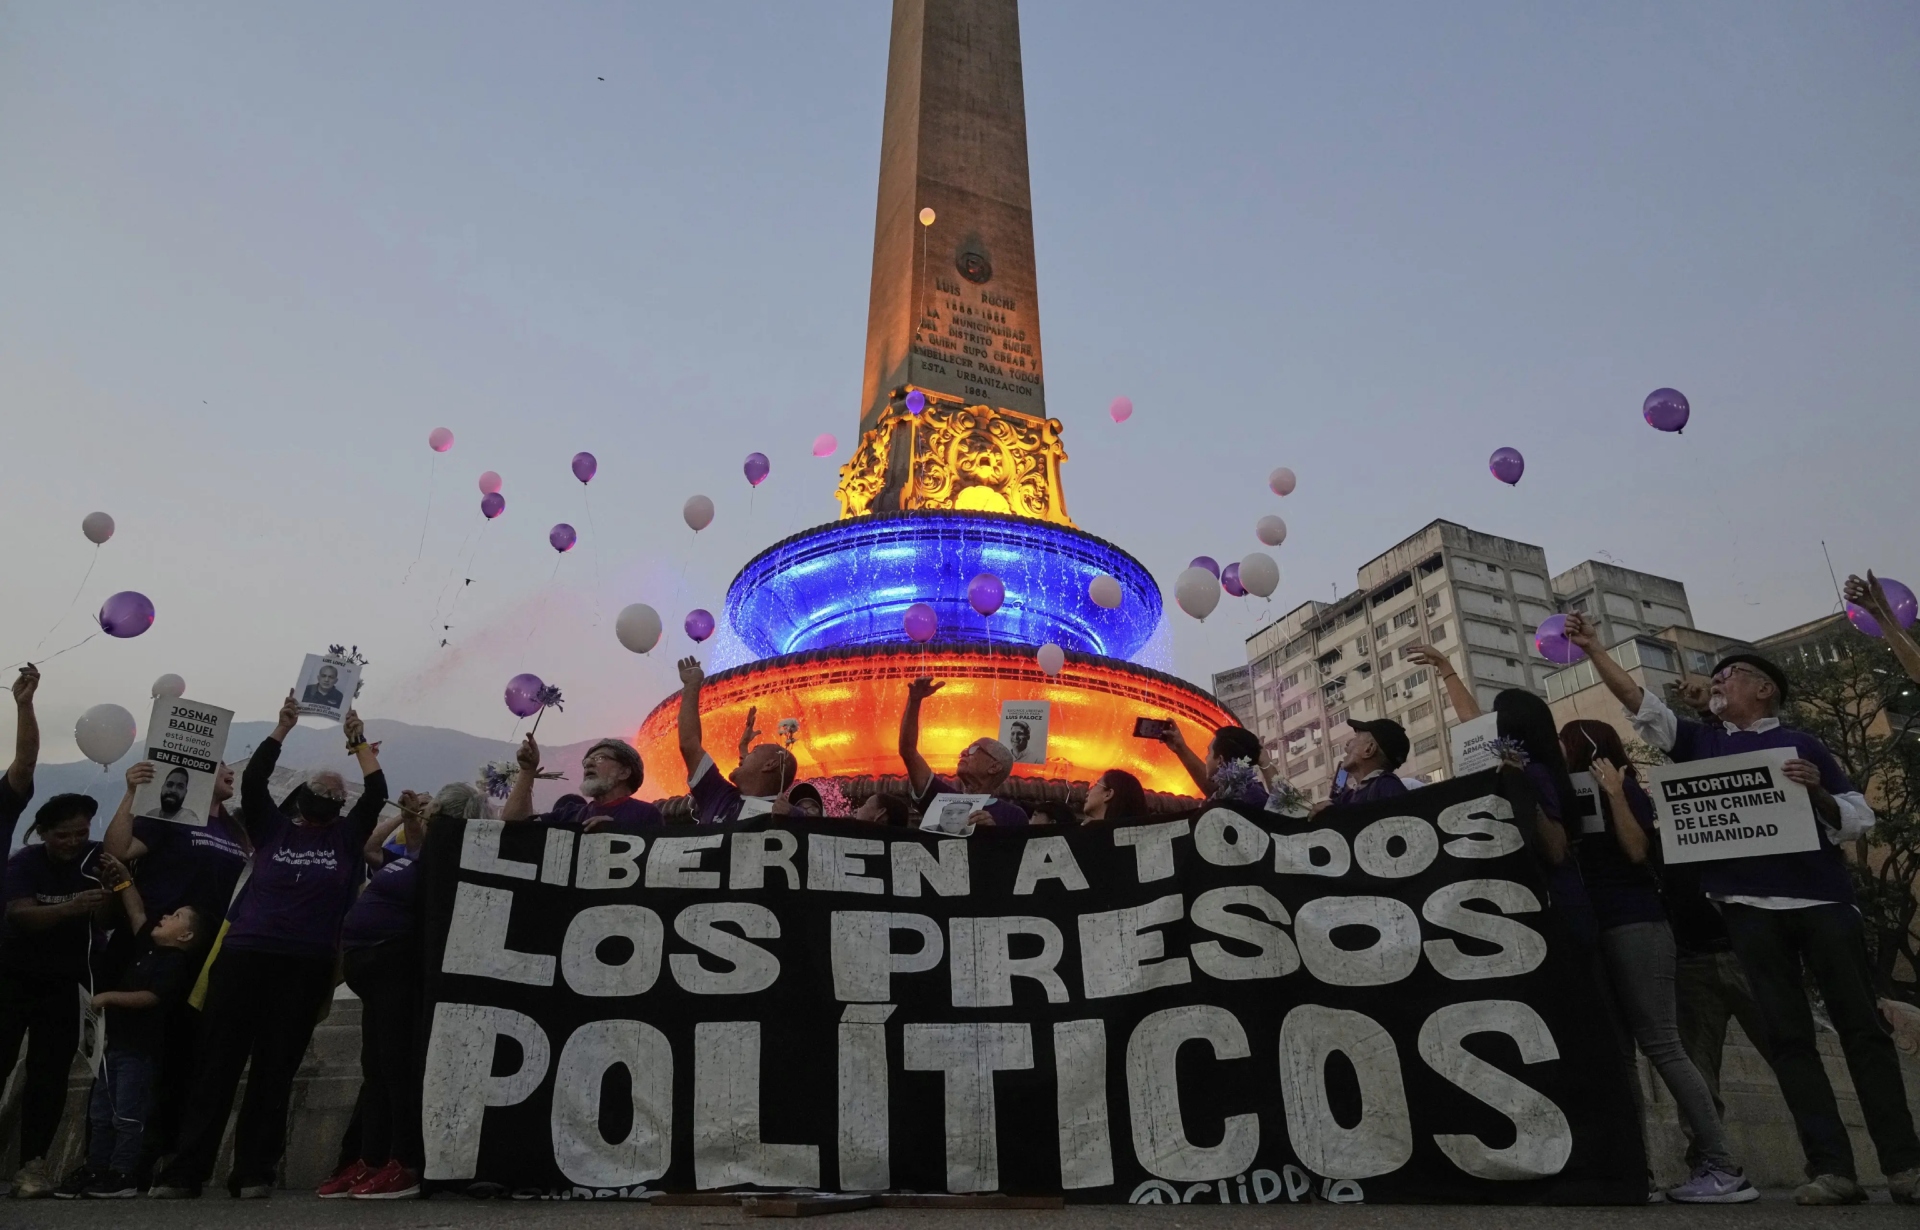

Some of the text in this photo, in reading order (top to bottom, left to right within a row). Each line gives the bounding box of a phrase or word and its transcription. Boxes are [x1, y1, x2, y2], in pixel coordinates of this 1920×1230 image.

[936, 279, 1016, 311] LUIS ROCHE
[926, 307, 1025, 342] LA MUNICIPALIDAD
[949, 326, 993, 346] DISTRITO
[929, 334, 957, 351] QUIEN
[963, 344, 988, 359] SUPO
[994, 351, 1026, 368] CREAR
[1031, 361, 1037, 371] Y
[914, 345, 1040, 385] EMBELLECER PARA TODOS
[921, 361, 1032, 396] ESTA URBANIZACION
[171, 706, 218, 723] JOSNAR
[165, 731, 211, 748] está siendo
[169, 719, 214, 737] BADUEL
[162, 739, 211, 758] torturado
[1462, 742, 1488, 756] ARMAS
[1463, 735, 1484, 748] JESÚS
[156, 751, 211, 771] EN EL RODEO
[1665, 771, 1768, 797] LA TORTURA
[1671, 790, 1786, 816] ES UN CRIMEN
[1674, 812, 1741, 831] DE LESA
[459, 795, 1524, 896] LIBEREN A TODOS
[1677, 823, 1779, 846] HUMANIDAD
[440, 882, 1548, 1006] LOS PRESOS
[421, 1000, 1573, 1191] POLÍTICOS
